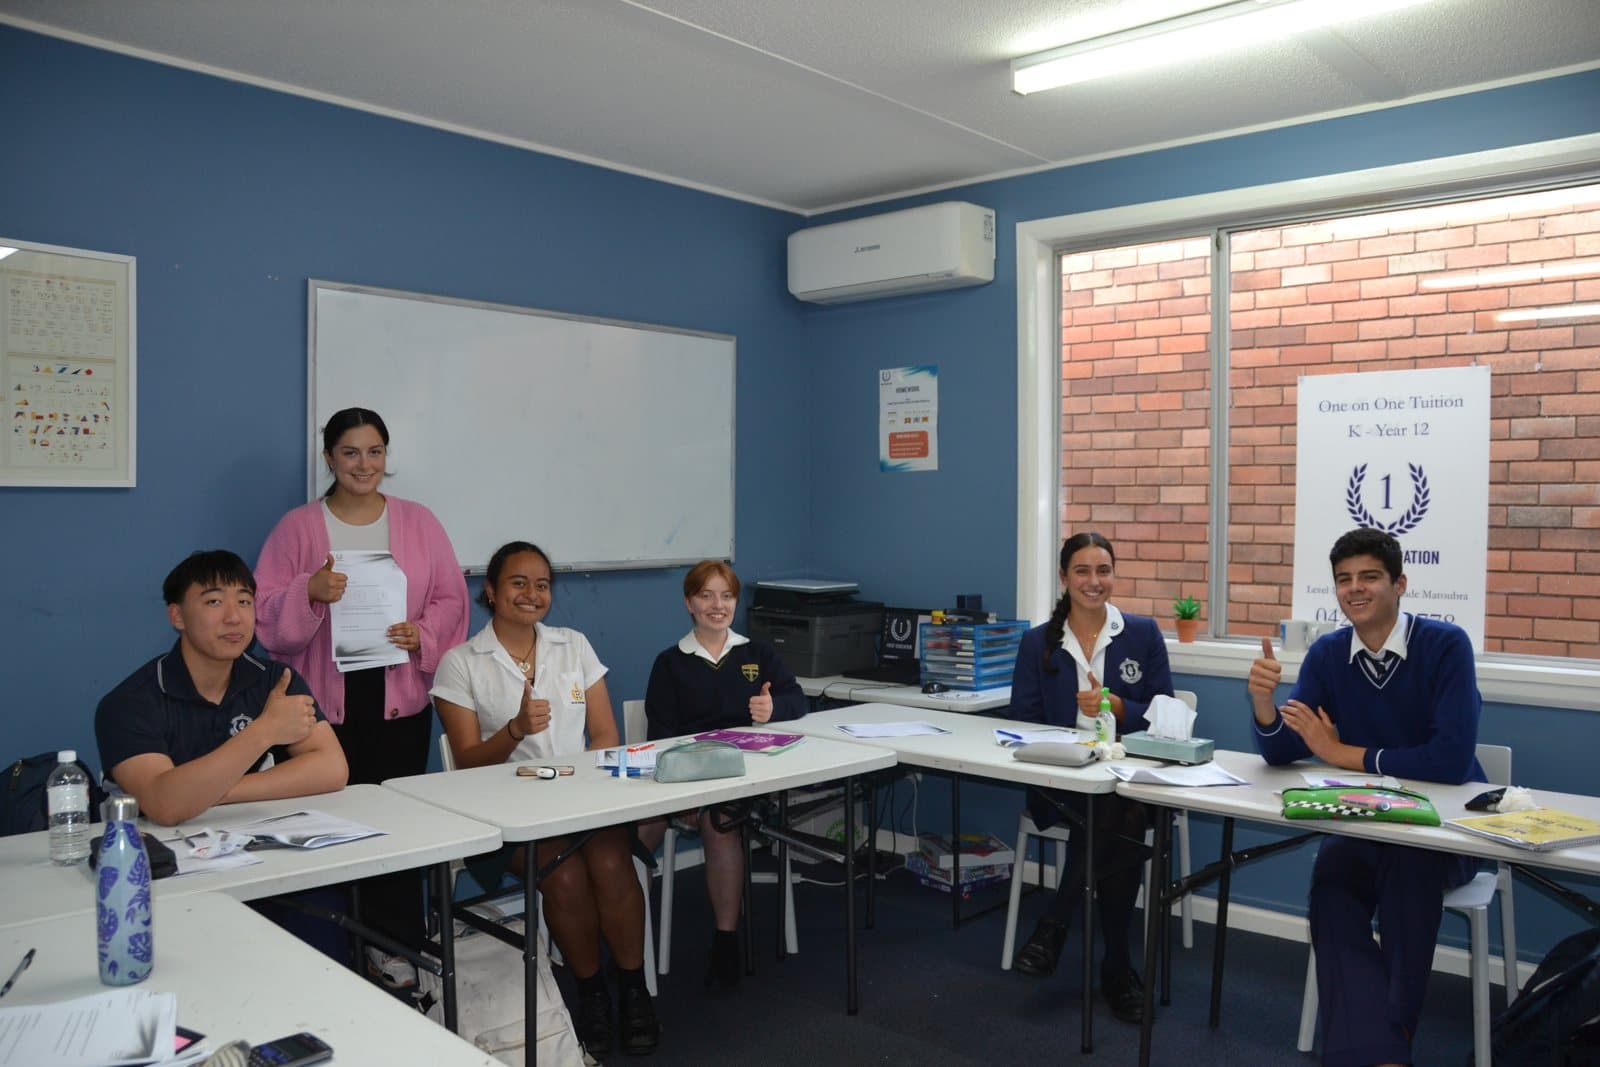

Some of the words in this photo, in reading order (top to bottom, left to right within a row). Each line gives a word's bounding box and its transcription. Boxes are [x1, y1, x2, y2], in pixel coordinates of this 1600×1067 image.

[1319, 399, 1348, 413] One
[1352, 402, 1369, 412] on
[1374, 397, 1406, 410] One
[1409, 394, 1464, 409] Tuition
[1348, 424, 1361, 438] K
[1376, 423, 1408, 437] Year
[1413, 422, 1430, 436] 12
[1380, 473, 1393, 510] 1
[1403, 549, 1440, 565] ATION
